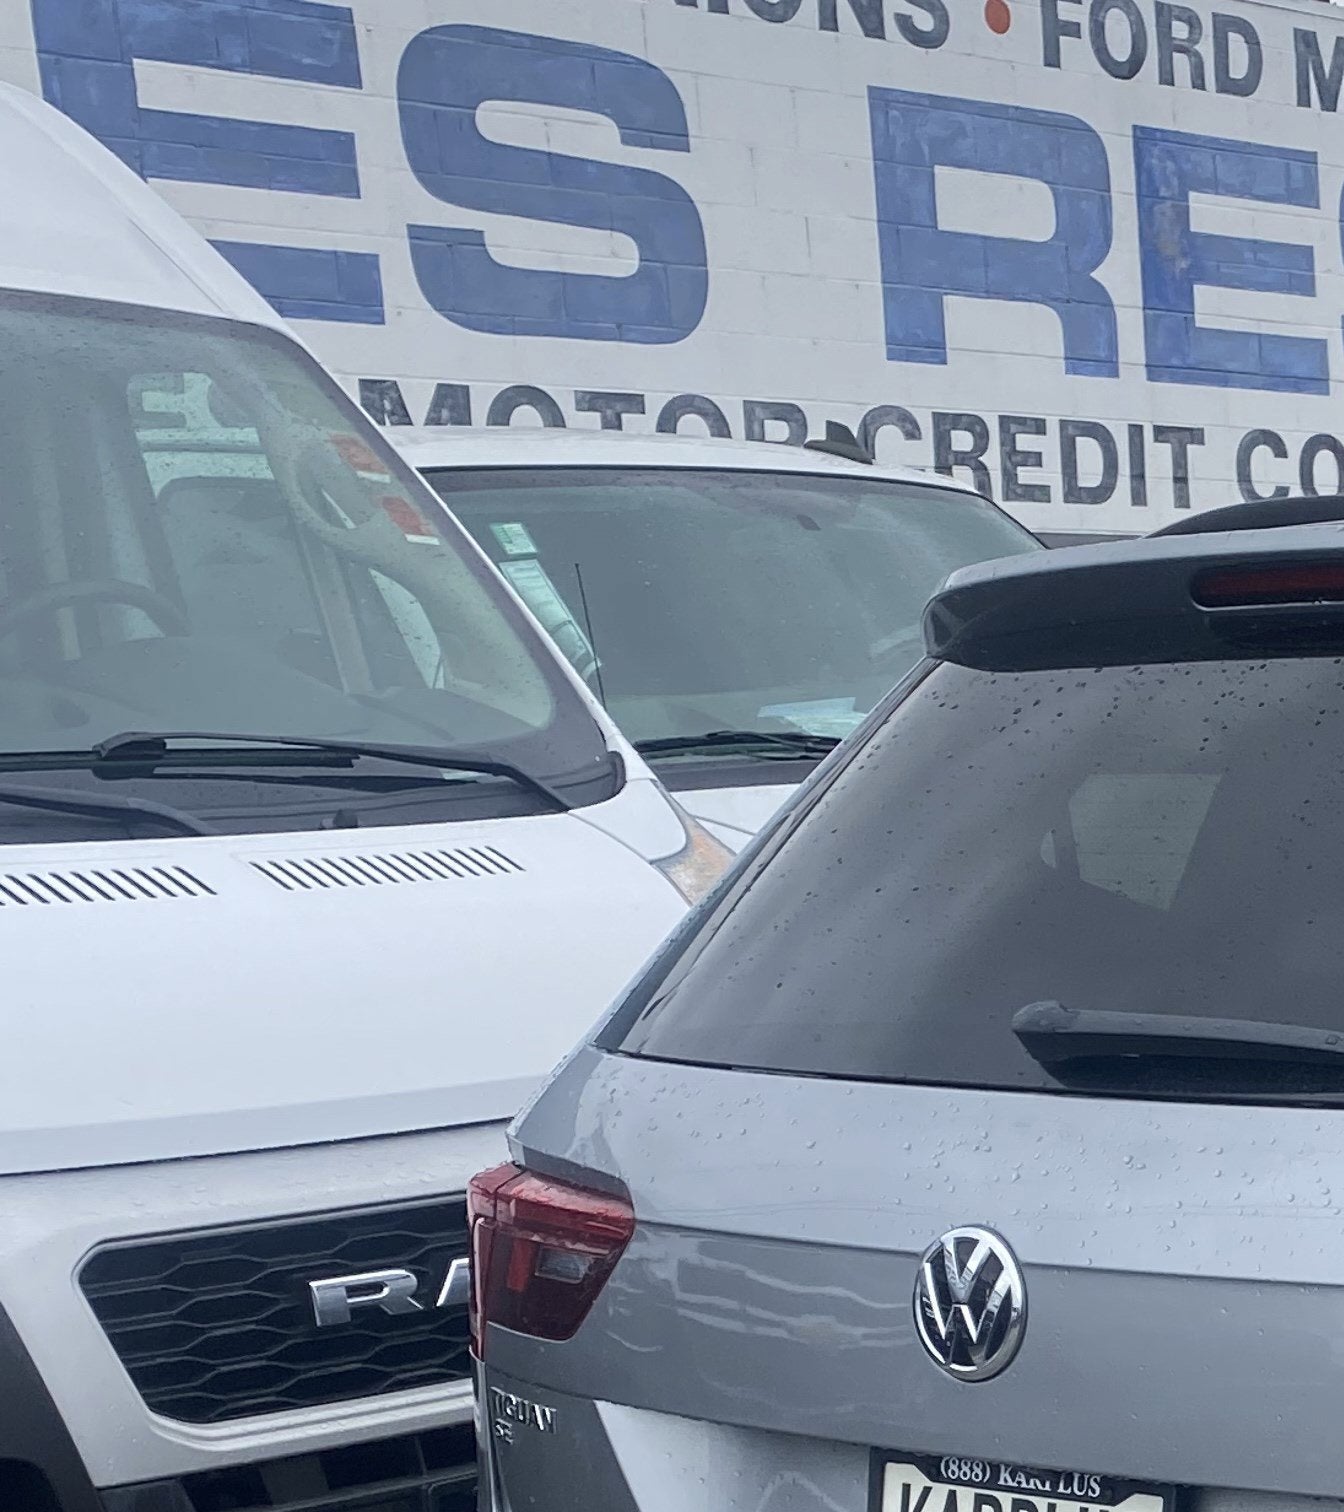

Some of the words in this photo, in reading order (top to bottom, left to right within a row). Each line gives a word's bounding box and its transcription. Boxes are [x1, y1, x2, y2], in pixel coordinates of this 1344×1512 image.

[1040, 0, 1263, 97] FORD
[857, 404, 1206, 509] CREDIT
[940, 1456, 992, 1484] (888)
